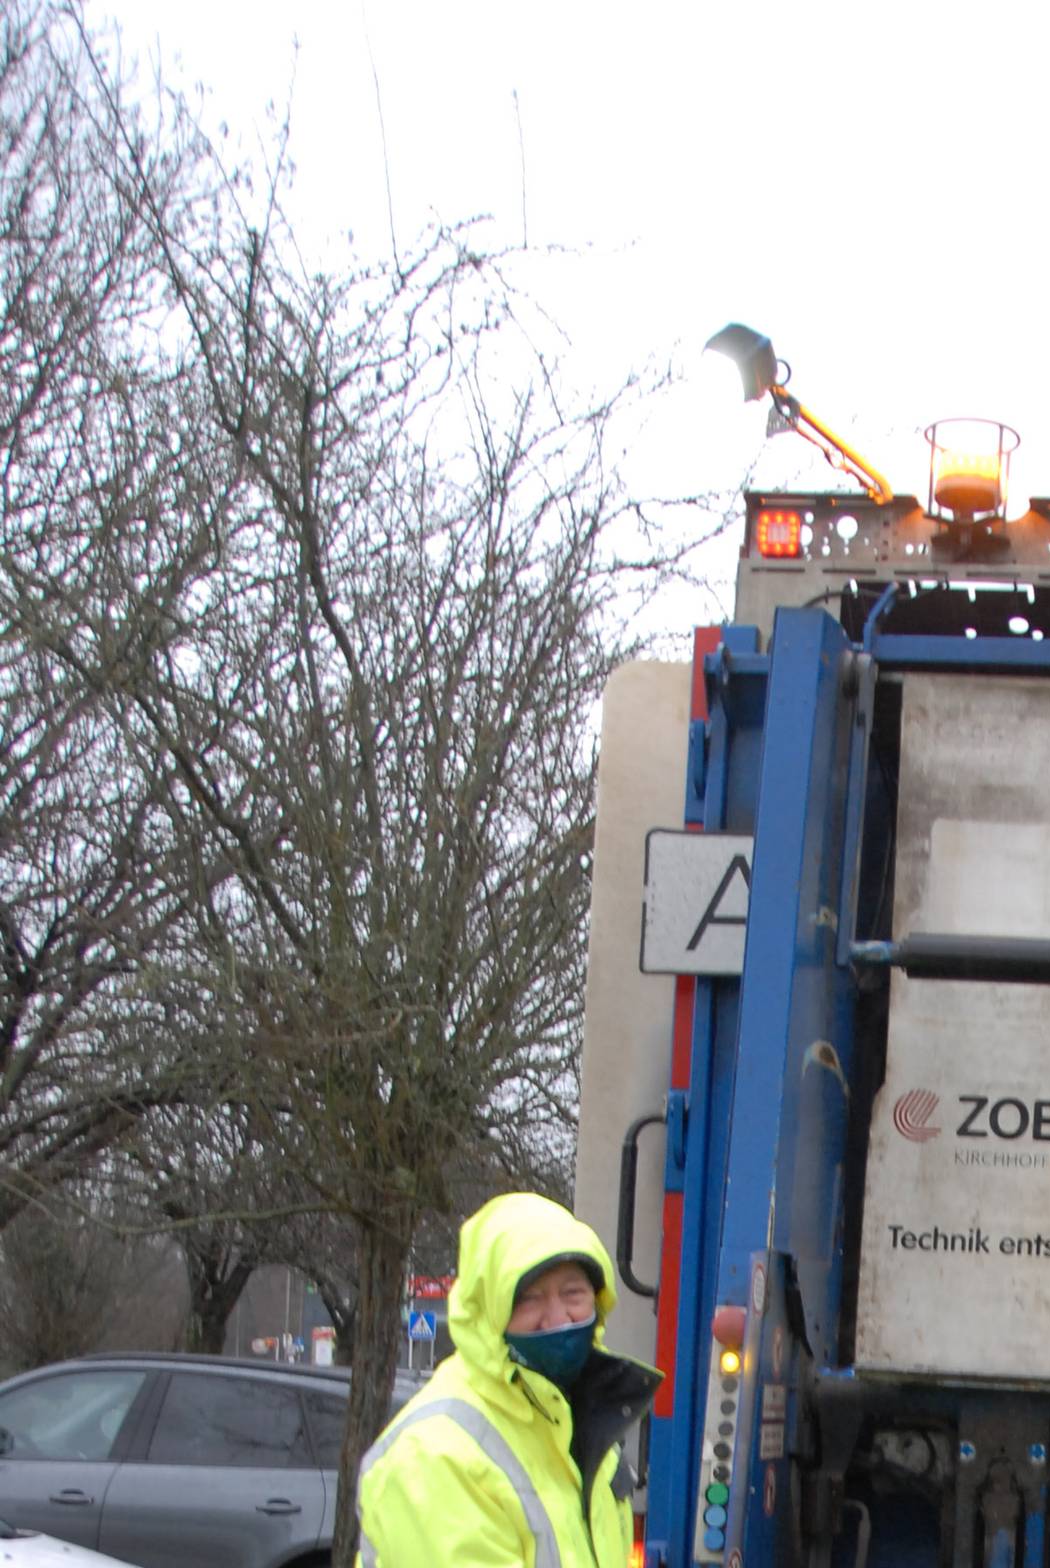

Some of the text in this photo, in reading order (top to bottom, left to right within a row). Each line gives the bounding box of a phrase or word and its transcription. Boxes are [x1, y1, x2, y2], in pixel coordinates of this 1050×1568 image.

[685, 853, 752, 951] A
[953, 1150, 1048, 1169] KIRCHHOFF
[888, 1225, 991, 1254] Technik
